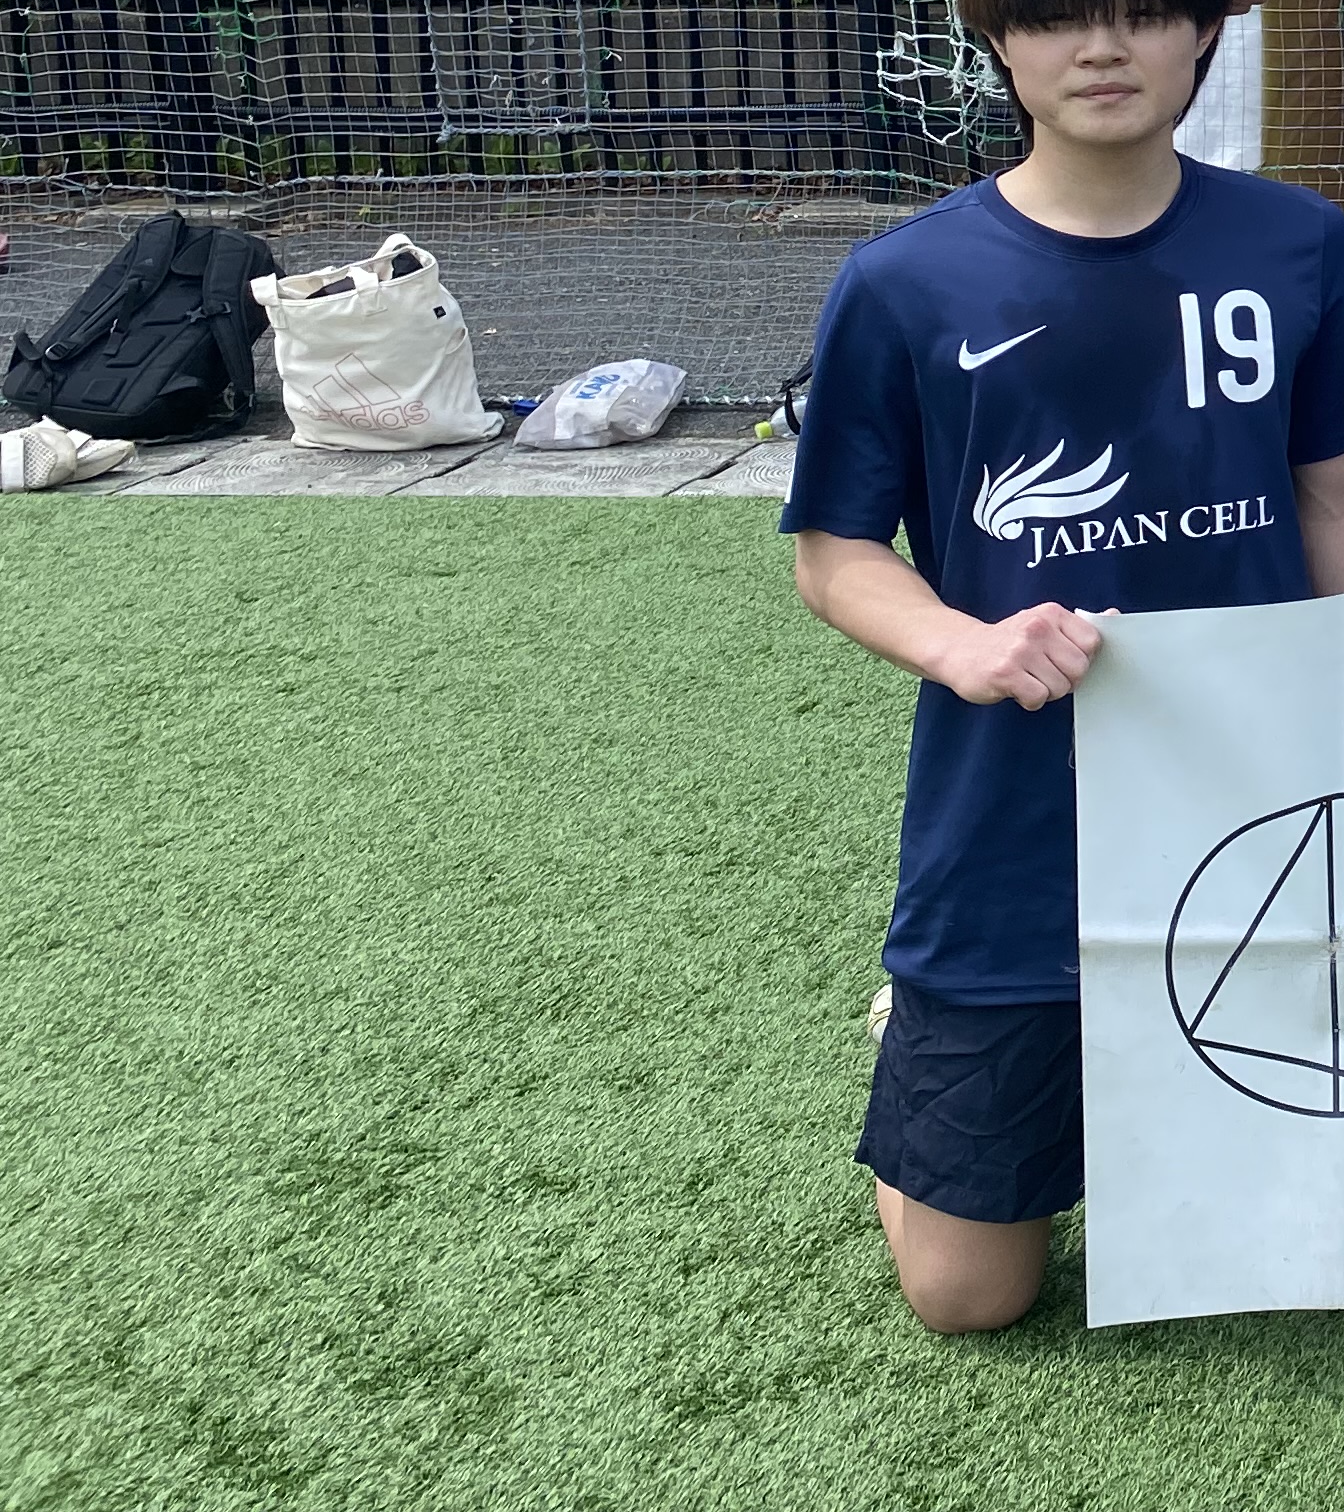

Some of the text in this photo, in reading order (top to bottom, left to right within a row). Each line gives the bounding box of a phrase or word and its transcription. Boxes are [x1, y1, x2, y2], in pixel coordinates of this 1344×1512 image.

[1179, 289, 1275, 408] 19
[1026, 495, 1275, 569] JAPAN CELL
